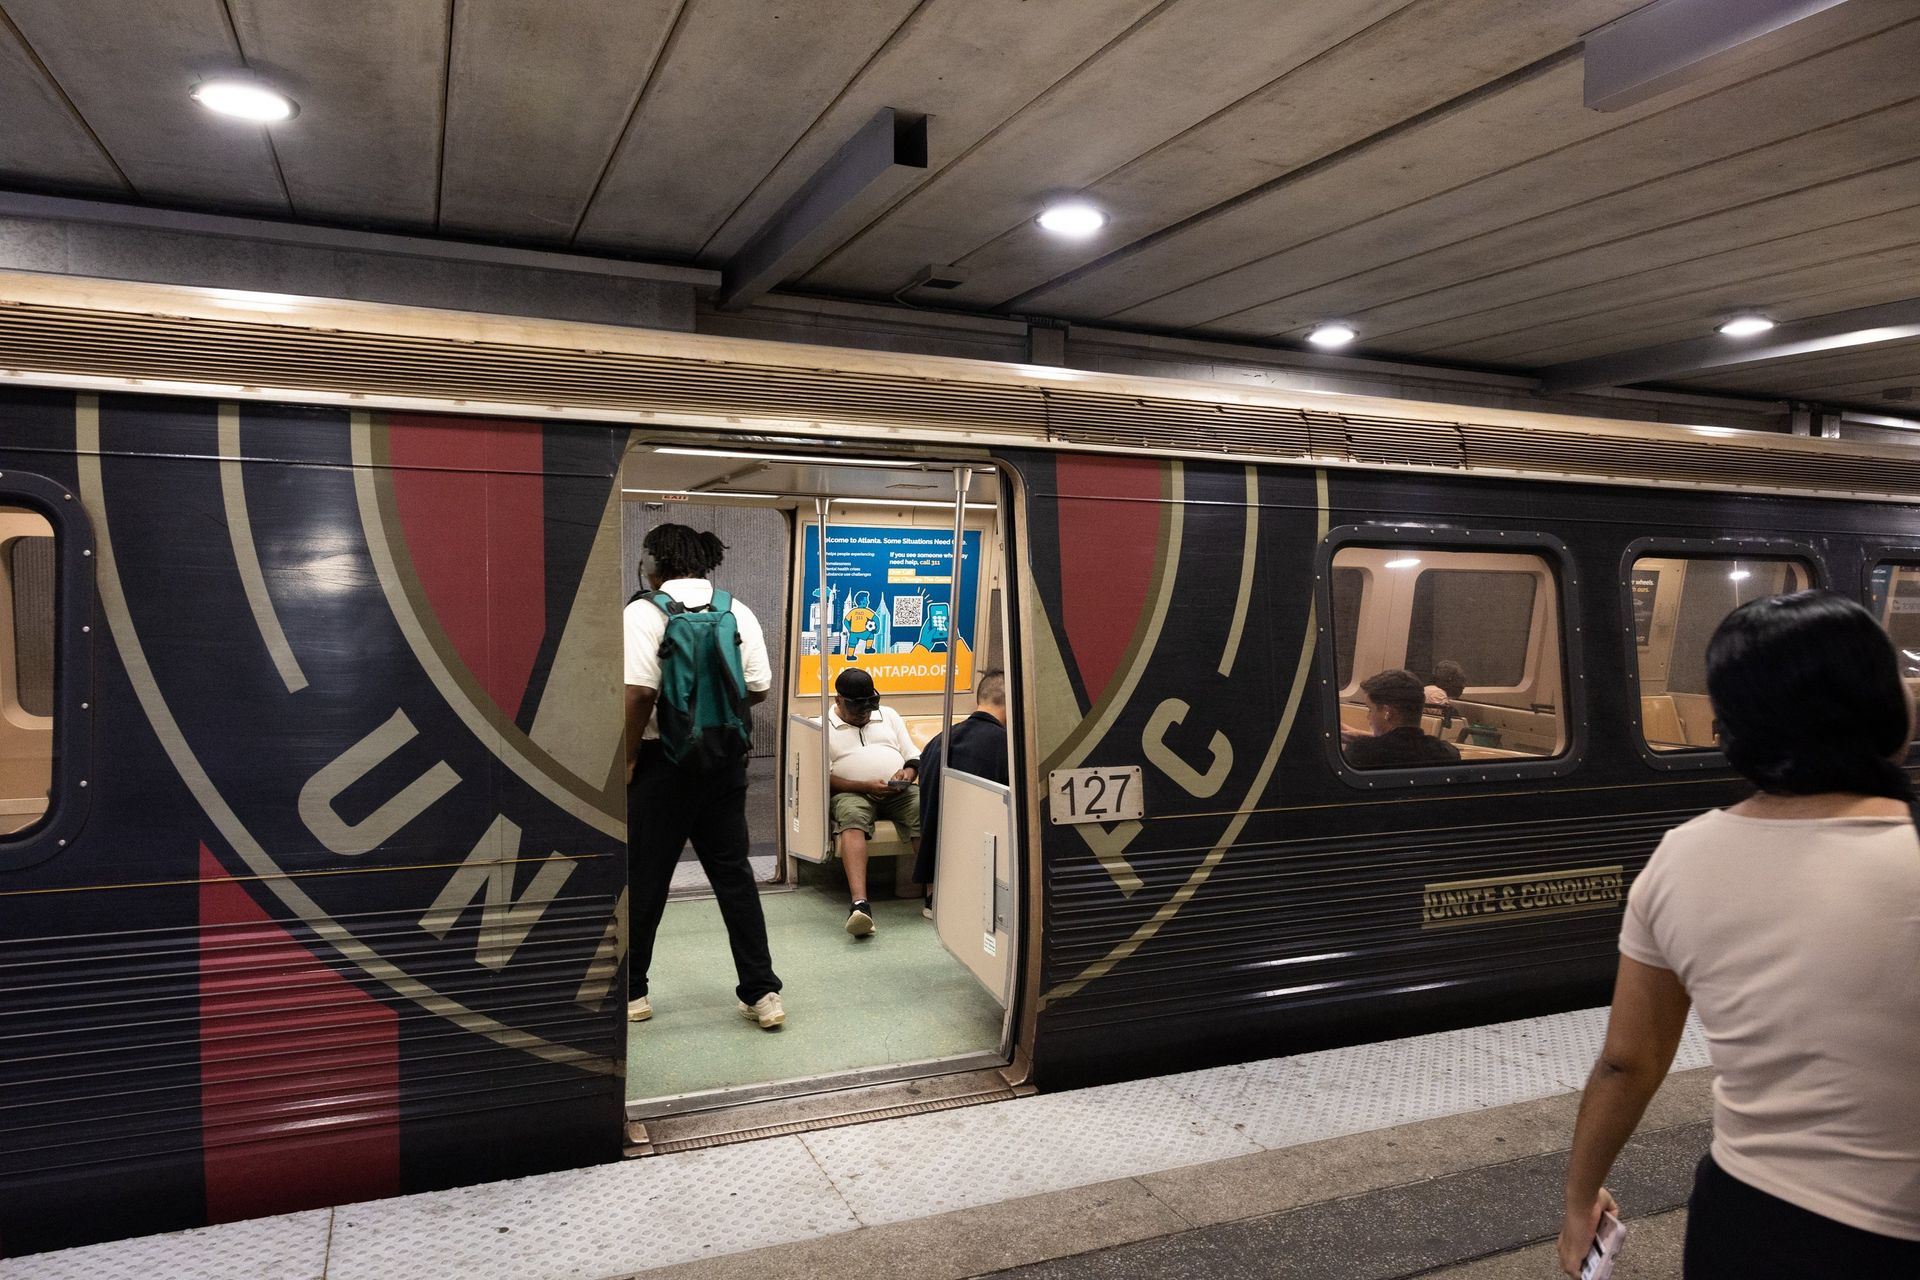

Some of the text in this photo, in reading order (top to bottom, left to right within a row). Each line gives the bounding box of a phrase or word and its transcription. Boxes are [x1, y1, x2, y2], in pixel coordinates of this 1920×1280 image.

[902, 537, 933, 545] Situations
[1060, 774, 1131, 817] 127
[1430, 875, 1615, 919] UNITE & CONQUER
